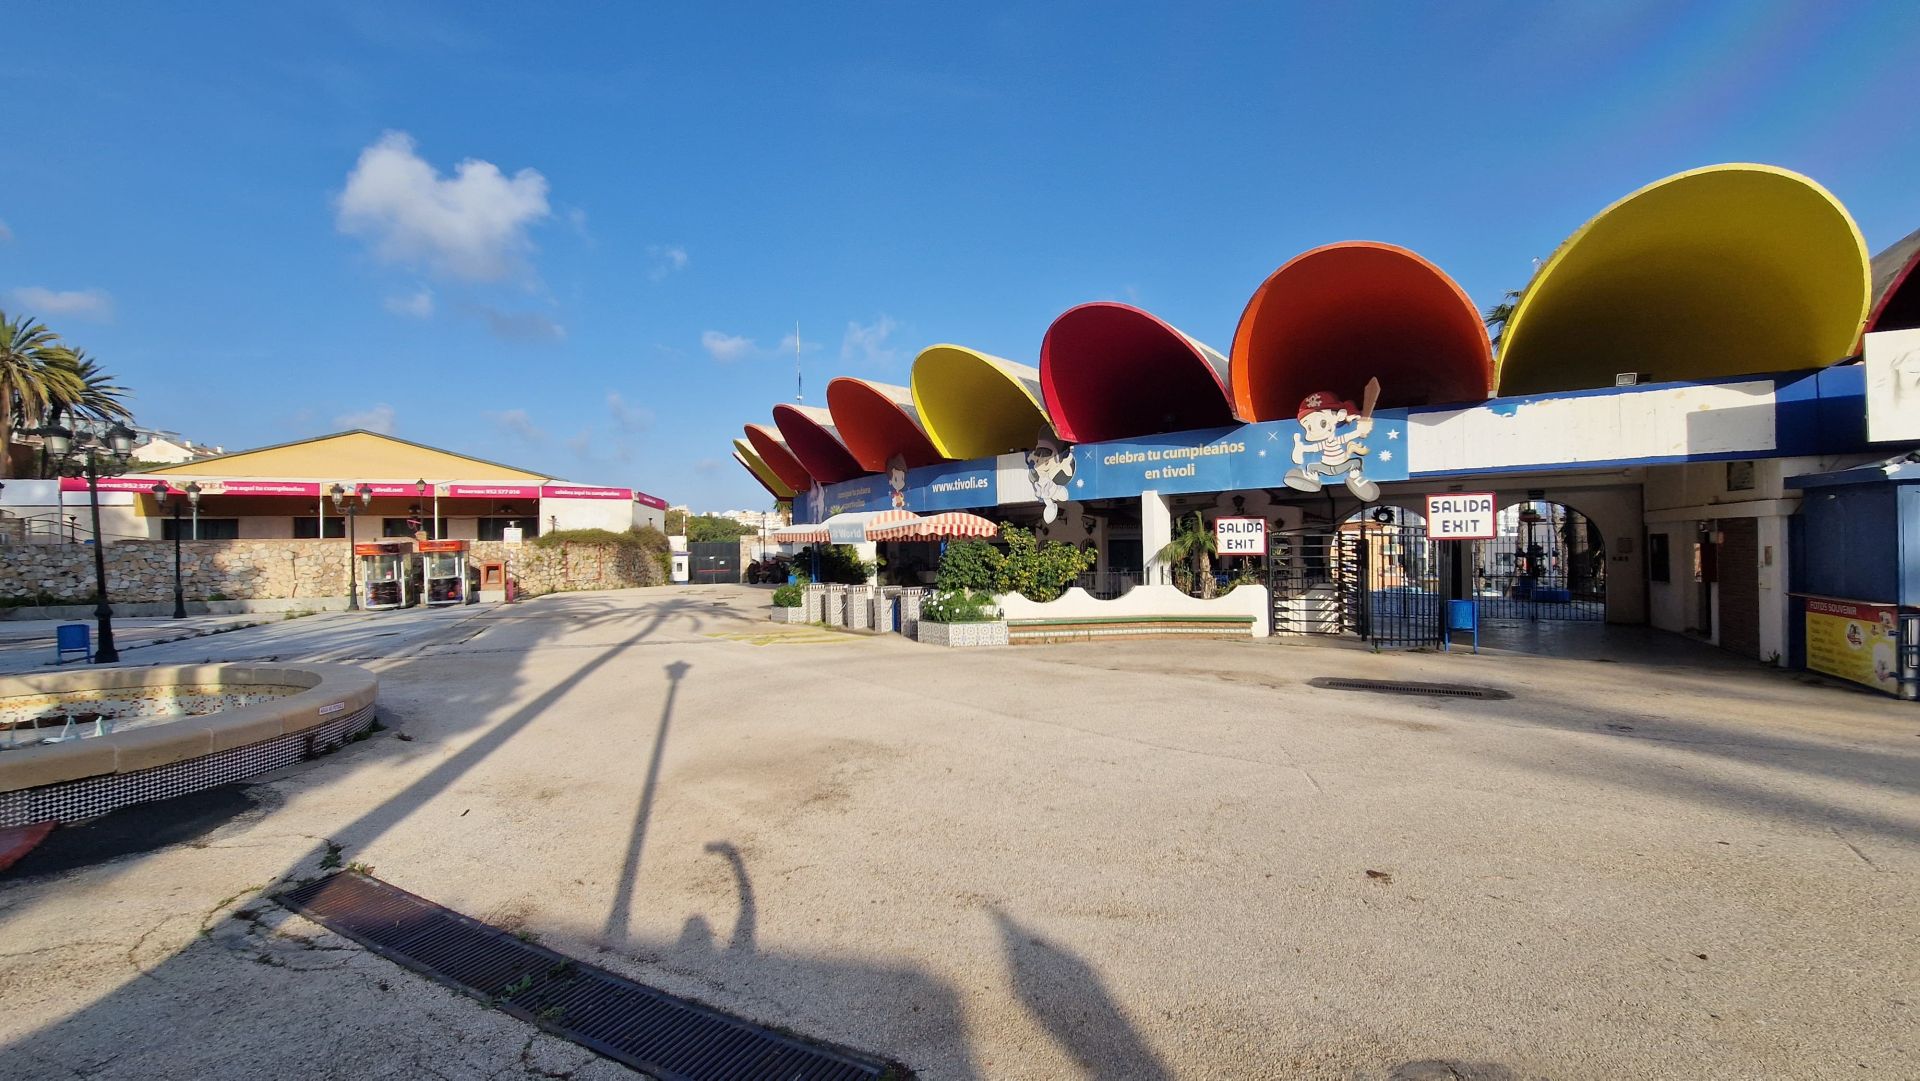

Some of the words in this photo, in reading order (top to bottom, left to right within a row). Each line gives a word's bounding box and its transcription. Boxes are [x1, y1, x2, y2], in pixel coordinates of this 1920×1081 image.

[1104, 452, 1145, 465] celebra
[1148, 451, 1161, 461] tu
[1163, 441, 1246, 459] cumpleaños
[1144, 470, 1160, 479] en
[1163, 463, 1196, 478] tivoli
[931, 477, 989, 493] www.tivoli.es
[1430, 499, 1491, 513] SALIDA
[839, 527, 862, 538] World
[1218, 522, 1263, 533] SALIDA
[1442, 519, 1480, 533] EXIT
[1227, 539, 1255, 549] EXIT
